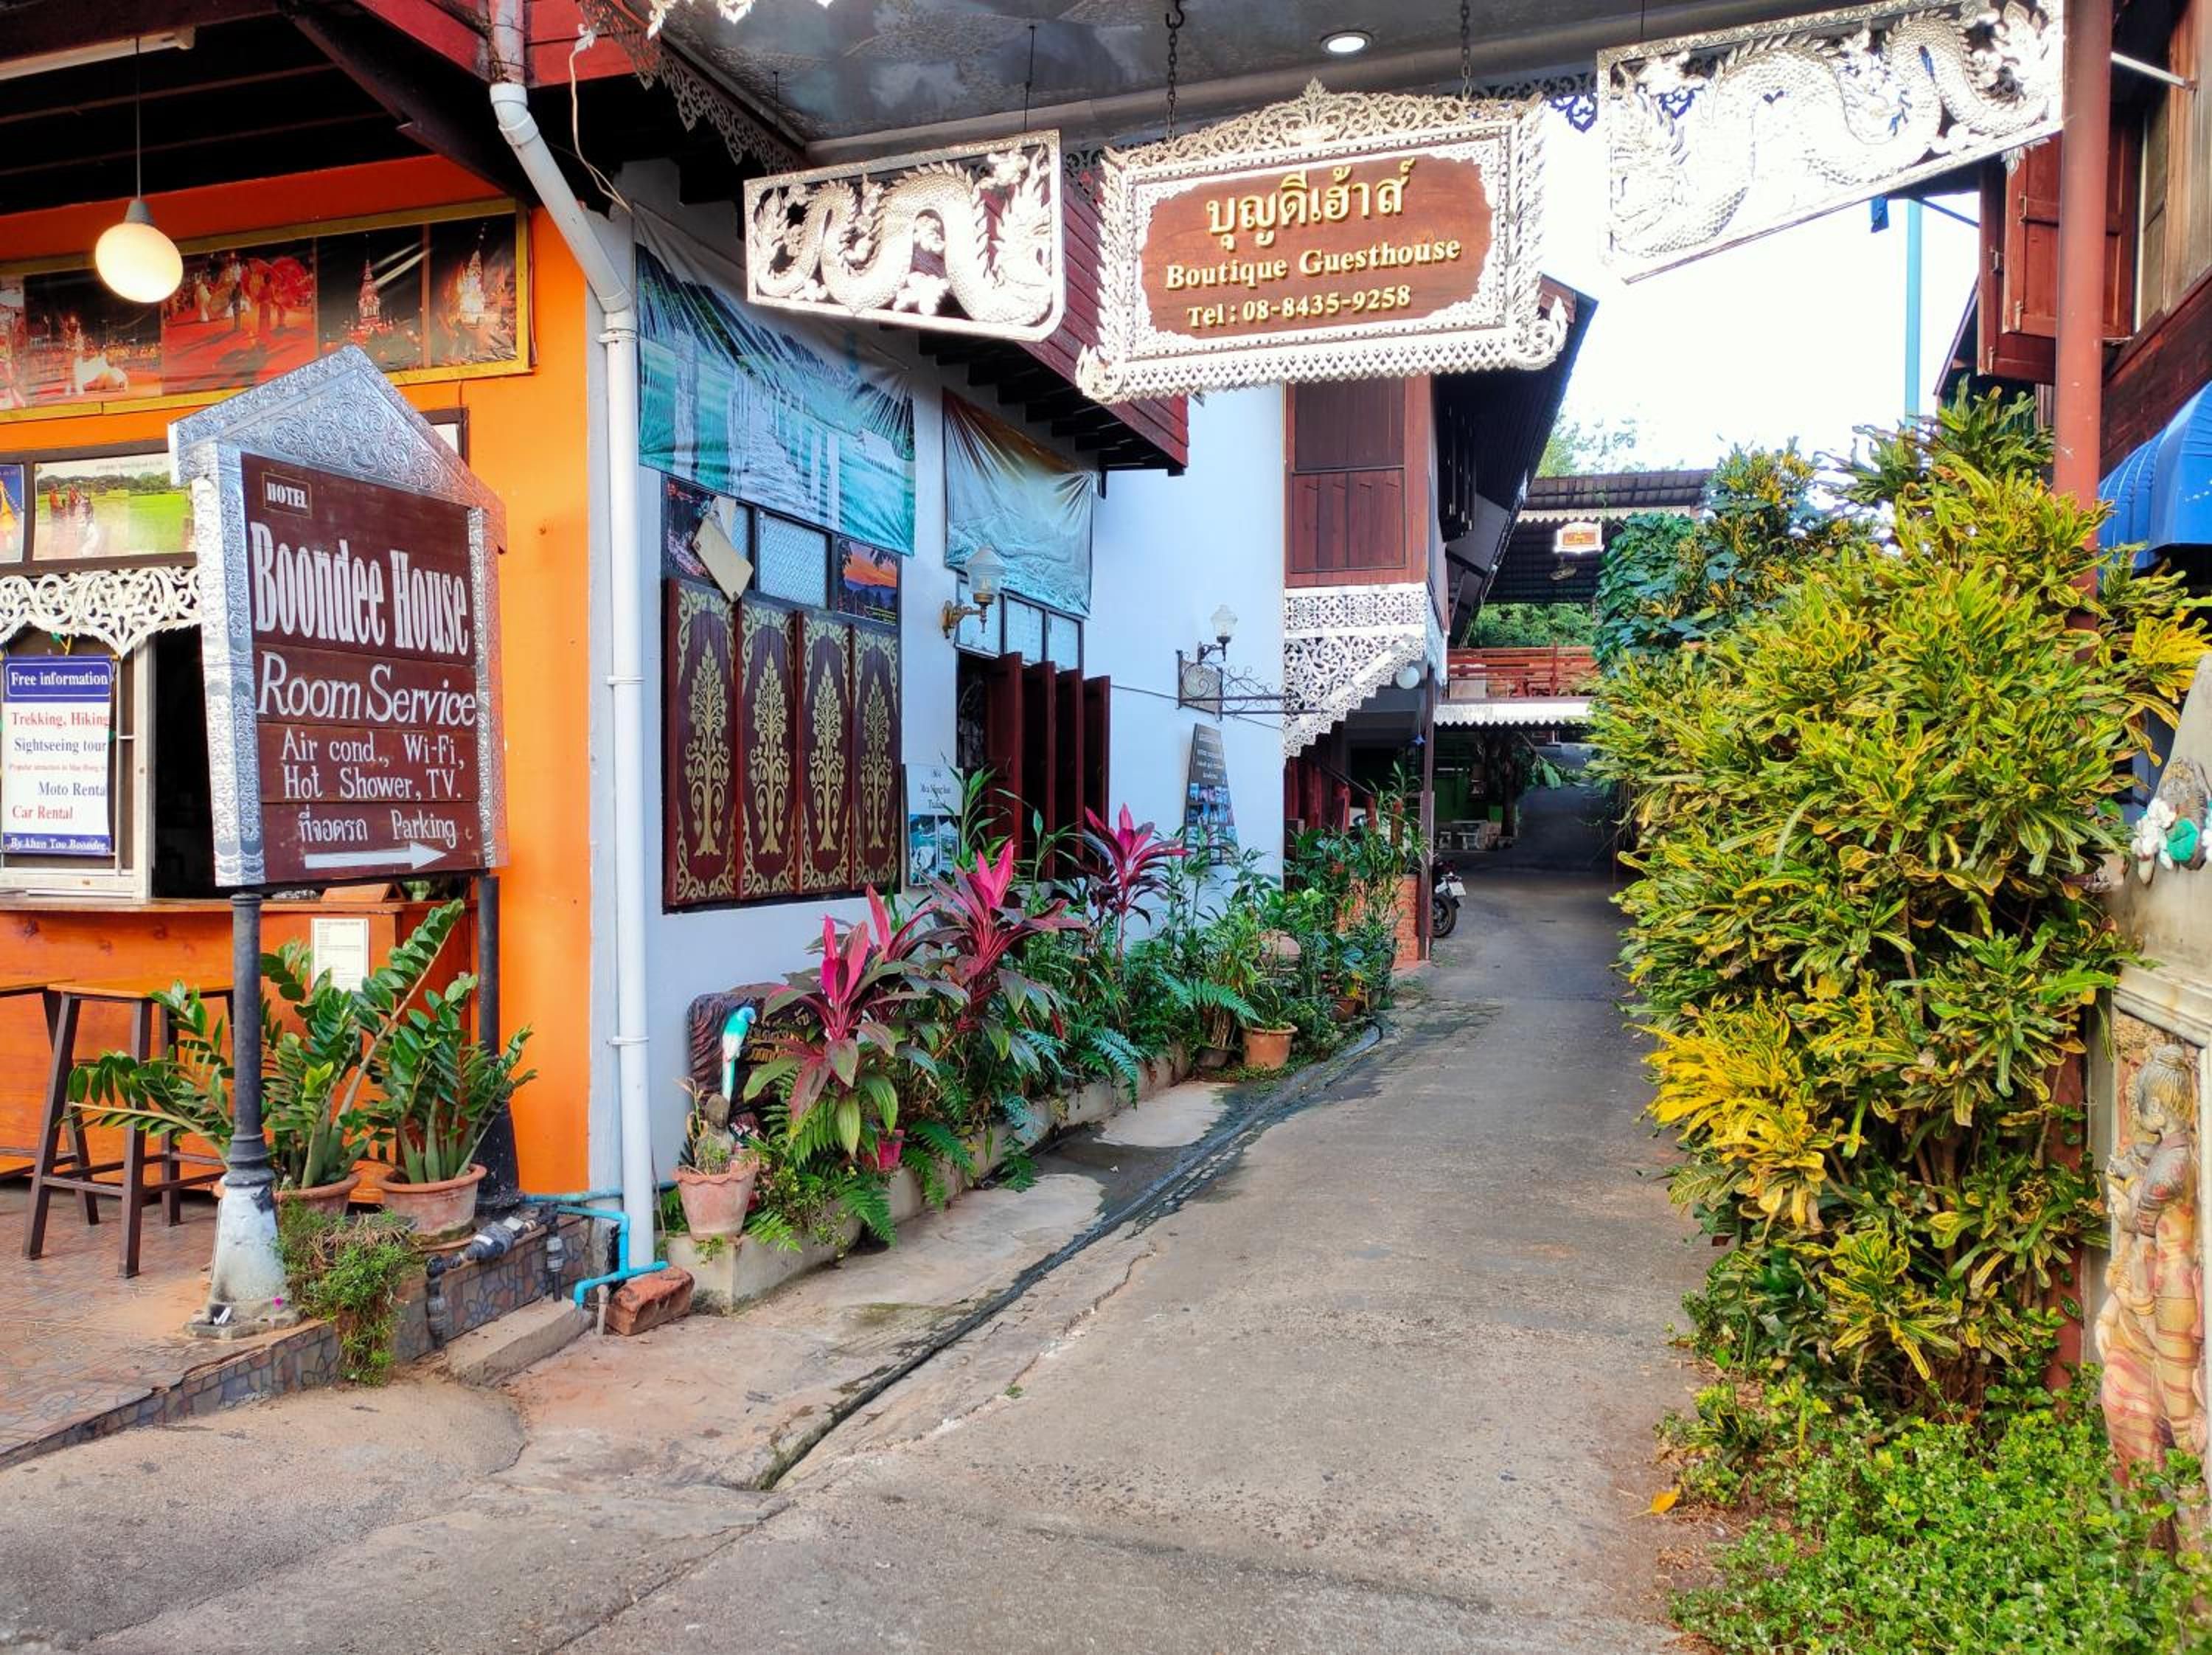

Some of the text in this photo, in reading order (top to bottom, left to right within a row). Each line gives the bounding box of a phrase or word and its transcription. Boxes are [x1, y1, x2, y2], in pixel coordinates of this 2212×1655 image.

[1206, 157, 1416, 251] บุญดีเฮ้าส์
[1166, 237, 1462, 290] Boutique Guesthouse
[1242, 285, 1411, 322] 08-8435-9258
[265, 482, 307, 508] HOTEL
[250, 521, 468, 656] Boondee House
[11, 670, 108, 685] Free information
[256, 650, 476, 726] Room Service
[12, 712, 110, 727] Trekking, Hiking
[14, 738, 107, 754] Sightseeing tour
[280, 726, 465, 770] Air cond., Wi-Fi,
[38, 781, 69, 796] Moto
[282, 764, 462, 802] Hot Shower, TV.
[13, 805, 73, 819] Car Rental
[298, 804, 456, 848] ที่จอดรถ Parking
